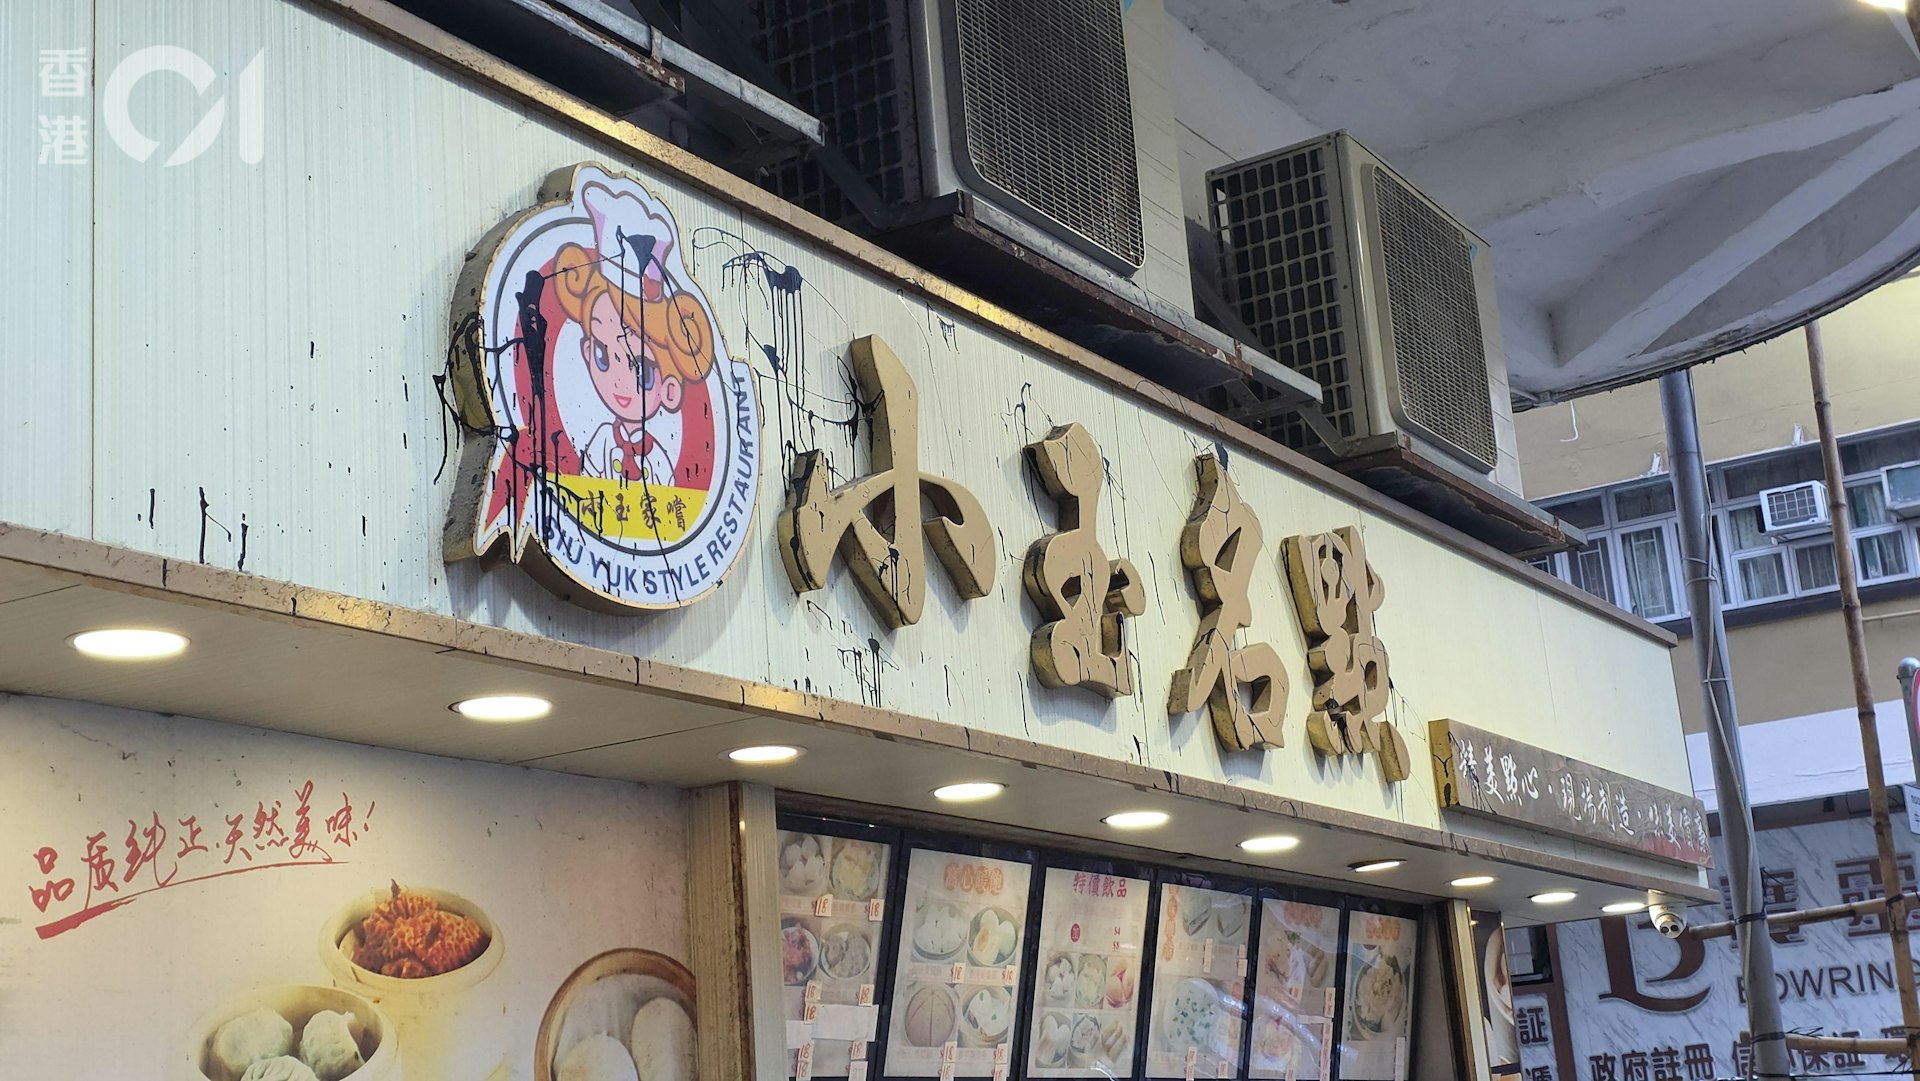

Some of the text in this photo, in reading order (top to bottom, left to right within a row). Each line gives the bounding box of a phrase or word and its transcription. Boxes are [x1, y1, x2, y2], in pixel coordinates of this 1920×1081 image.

[589, 551, 639, 594] YUK
[642, 553, 711, 595] STYLE
[706, 371, 755, 566] RESTAURANT
[1073, 872, 1127, 898] 特價飲品
[1589, 1042, 1714, 1081] 政府註冊
